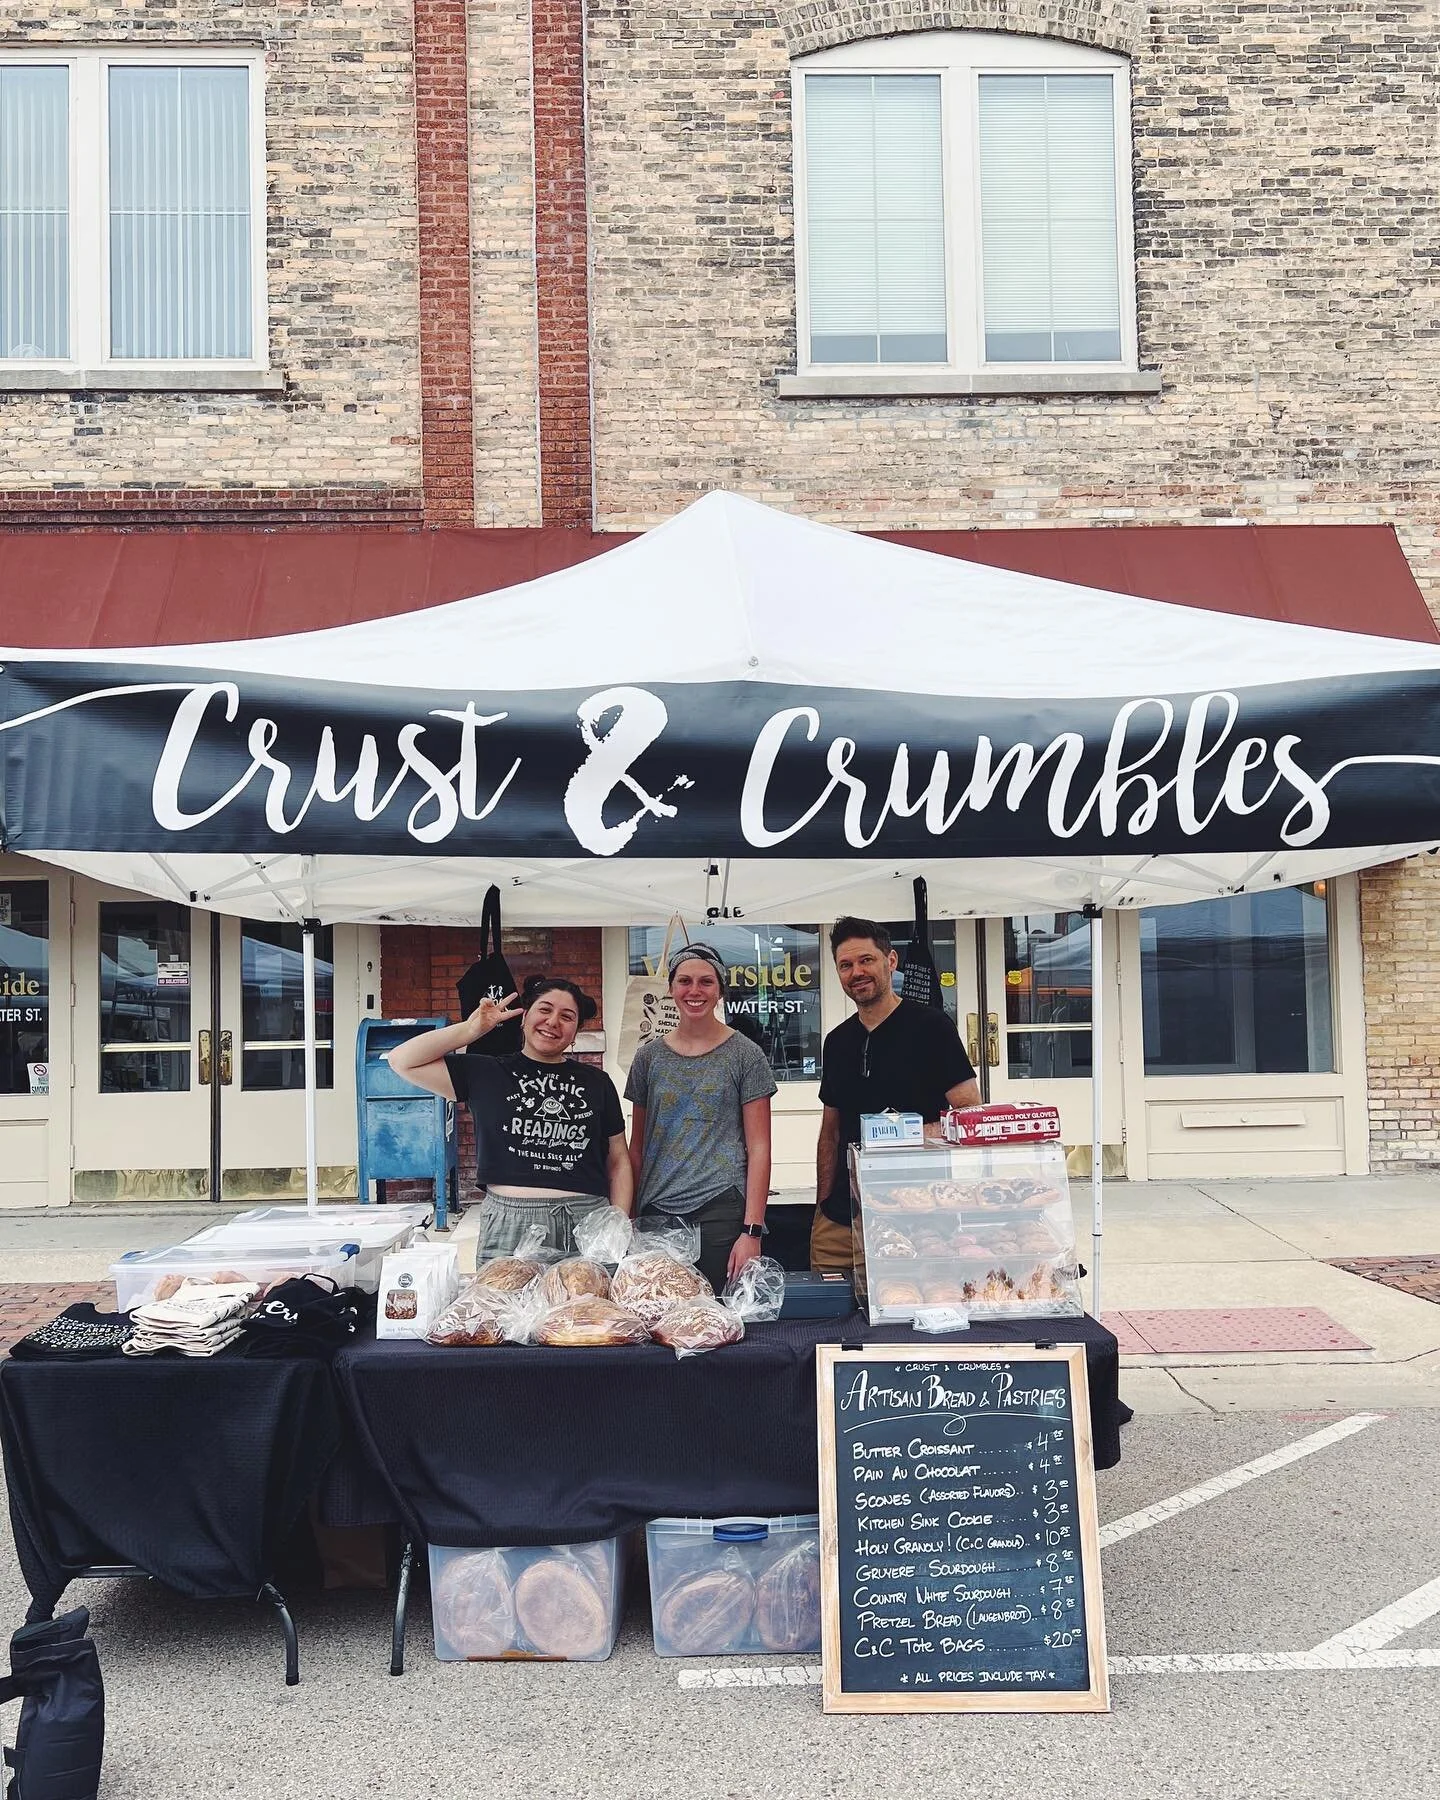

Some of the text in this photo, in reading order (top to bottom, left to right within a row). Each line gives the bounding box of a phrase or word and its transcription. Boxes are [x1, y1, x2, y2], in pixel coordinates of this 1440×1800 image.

[150, 682, 1332, 856] Crust & Crumbles
[0, 1008, 42, 1022] TER ST.
[727, 1001, 808, 1014] WATER ST.
[658, 1020, 681, 1028] SHOUL
[982, 1111, 1058, 1123] DOMESTIC POLY GLOVES
[511, 1117, 588, 1141] READINGS
[564, 1154, 579, 1162] ALL
[905, 1363, 938, 1371] CRUST
[957, 1363, 1002, 1371] CRUMBLES
[840, 1369, 1066, 1411] ARTISAN BREAD & PASTRIES
[853, 1442, 902, 1460] BUTTER
[908, 1438, 975, 1458] CROISSANT
[854, 1467, 884, 1482] PAIN
[914, 1464, 981, 1481] CHOCOLAT
[855, 1493, 912, 1510] SCONES
[920, 1489, 970, 1504] (ASSORTED
[858, 1516, 905, 1531] KITCHEN
[910, 1513, 940, 1530] SINK
[948, 1511, 994, 1528] COOKIE
[855, 1539, 889, 1556] HOLY
[856, 1565, 915, 1581] GRUYERE
[929, 1559, 996, 1577] SOURDOUGH
[853, 1586, 908, 1608] COUNTRY
[916, 1585, 950, 1604] WHITE
[953, 1587, 1012, 1603] SOURDOUGH
[857, 1611, 916, 1631] PRETZEL
[922, 1611, 962, 1630] BREAD
[940, 1637, 986, 1652] BAGS
[915, 1671, 1047, 1683] ALL PRICES INCLUDE TAX
